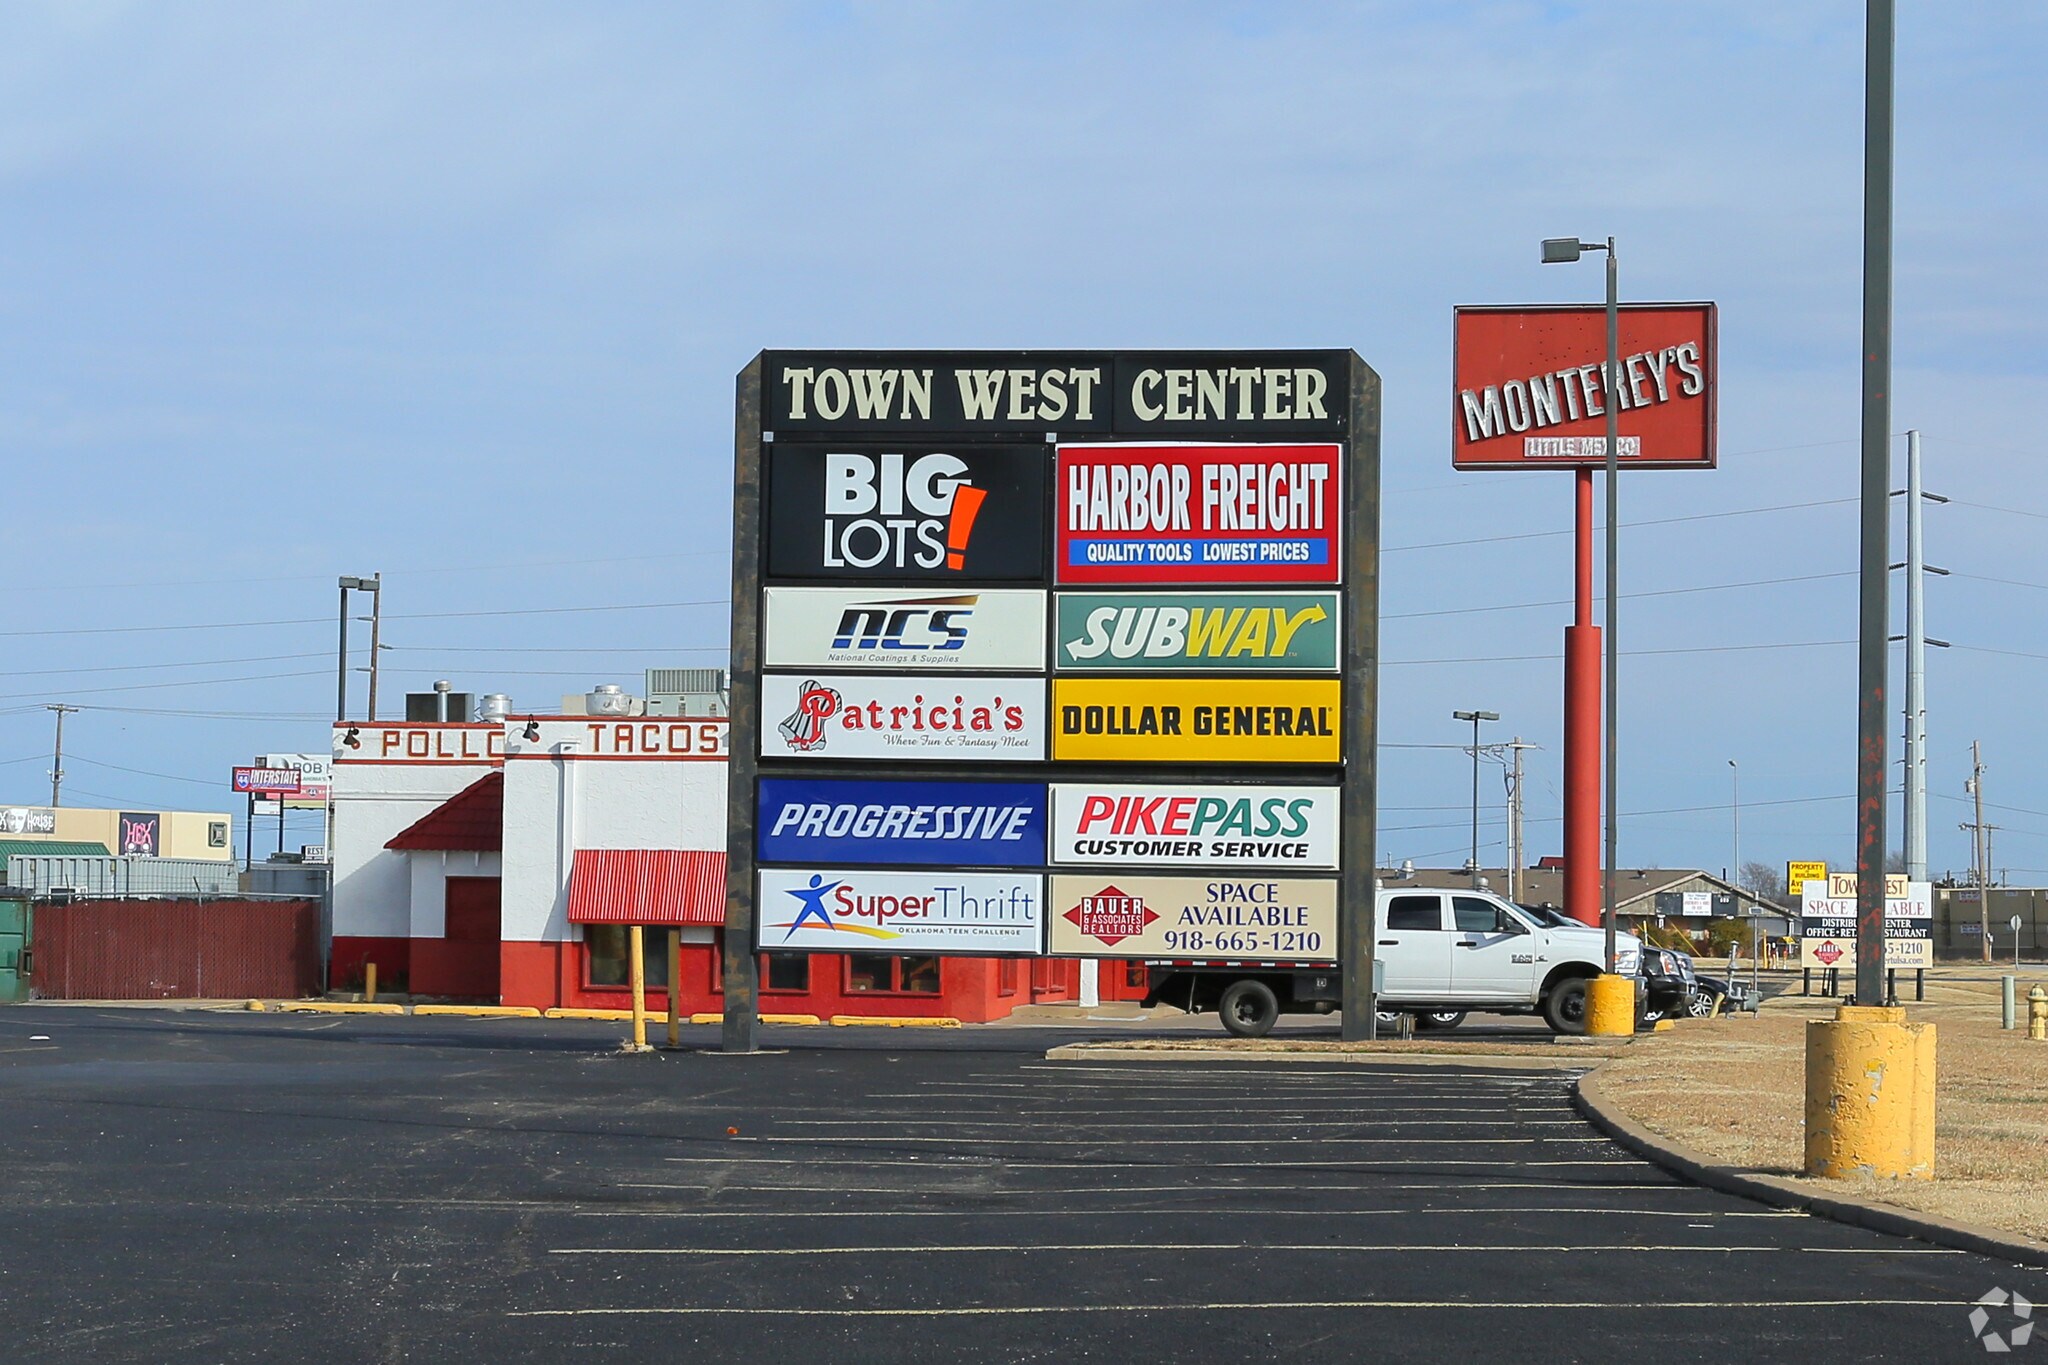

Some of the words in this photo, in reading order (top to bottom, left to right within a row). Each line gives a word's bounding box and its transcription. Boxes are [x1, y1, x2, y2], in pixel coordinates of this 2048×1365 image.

[783, 368, 933, 421] TOWN
[955, 368, 1101, 421] WEST
[1131, 368, 1328, 421] CENTER
[1461, 341, 1704, 441] MONTEREY'S
[825, 453, 970, 516] BIG
[1069, 463, 1191, 531] HARBOR
[1202, 463, 1329, 531] FREIGHT
[1087, 544, 1146, 562] QUALITY
[1148, 544, 1192, 561] TOOLS
[1203, 543, 1257, 561] LOWEST
[1260, 543, 1309, 560] PRICES
[1065, 603, 1327, 661] SUBWAY
[828, 653, 866, 662] National
[868, 654, 908, 664] Coatings
[911, 654, 917, 662] &
[920, 655, 959, 664] Supplies
[801, 689, 1025, 744] Patricia's
[1062, 705, 1181, 735] DOLLAR
[1194, 707, 1333, 736] GENERAL
[588, 724, 718, 753] TACOS
[884, 734, 918, 746] Where
[919, 735, 942, 746] Fun
[945, 737, 955, 746] &
[957, 736, 998, 749] Fantasy
[1001, 736, 1030, 747] Meet
[250, 769, 299, 784] INTERSTATE
[771, 804, 1032, 841] PROGRESSIVE
[1076, 796, 1314, 838] PIKEPASS
[123, 819, 156, 852] HEX
[1074, 840, 1203, 856] CUSTOMER
[1210, 842, 1309, 858] SERVICE
[1207, 884, 1278, 903] SPACE
[1885, 880, 1904, 895] EST
[1083, 898, 1142, 915] BAUER
[1808, 900, 1848, 915] SPACE
[1083, 916, 1090, 924] &
[1092, 915, 1142, 925] ASSOCIATES
[1178, 907, 1308, 926] AVAILABLE
[1885, 920, 1911, 929] ENTER
[898, 927, 945, 935] OKLAHOMA
[948, 928, 969, 936] TEEN
[972, 928, 1020, 936] CHALLENGE
[1083, 925, 1142, 935] REALTORS
[1884, 929, 1927, 938] STAURANT
[1164, 931, 1321, 951] 918-665-1210
